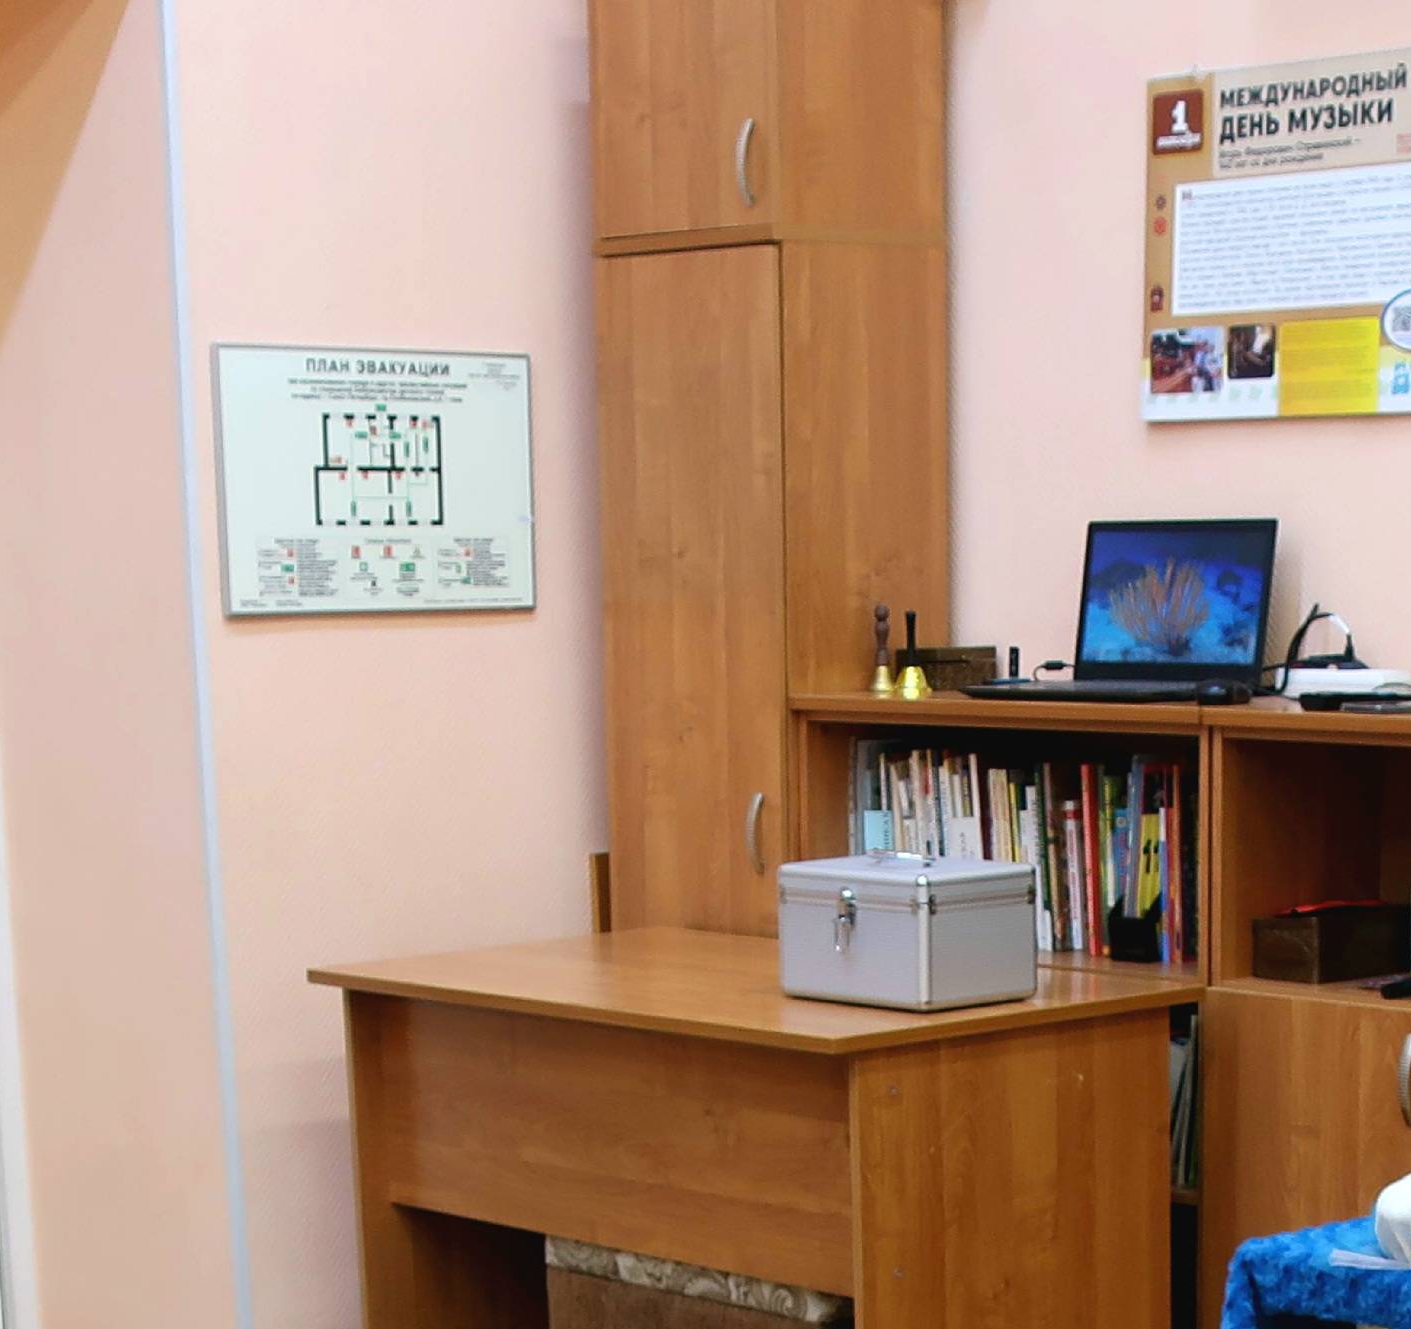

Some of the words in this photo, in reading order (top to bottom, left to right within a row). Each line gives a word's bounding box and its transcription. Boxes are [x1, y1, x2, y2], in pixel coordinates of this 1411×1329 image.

[1219, 62, 1408, 108] МЕЖДУНАРОДНЫЙ
[1170, 100, 1189, 133] 1
[1219, 109, 1279, 145] ДЕНЬ
[1288, 97, 1394, 132] МУЗЫКИ
[305, 358, 350, 373] ПЛАН
[356, 359, 450, 378] ЭВАКУАЦИИ
